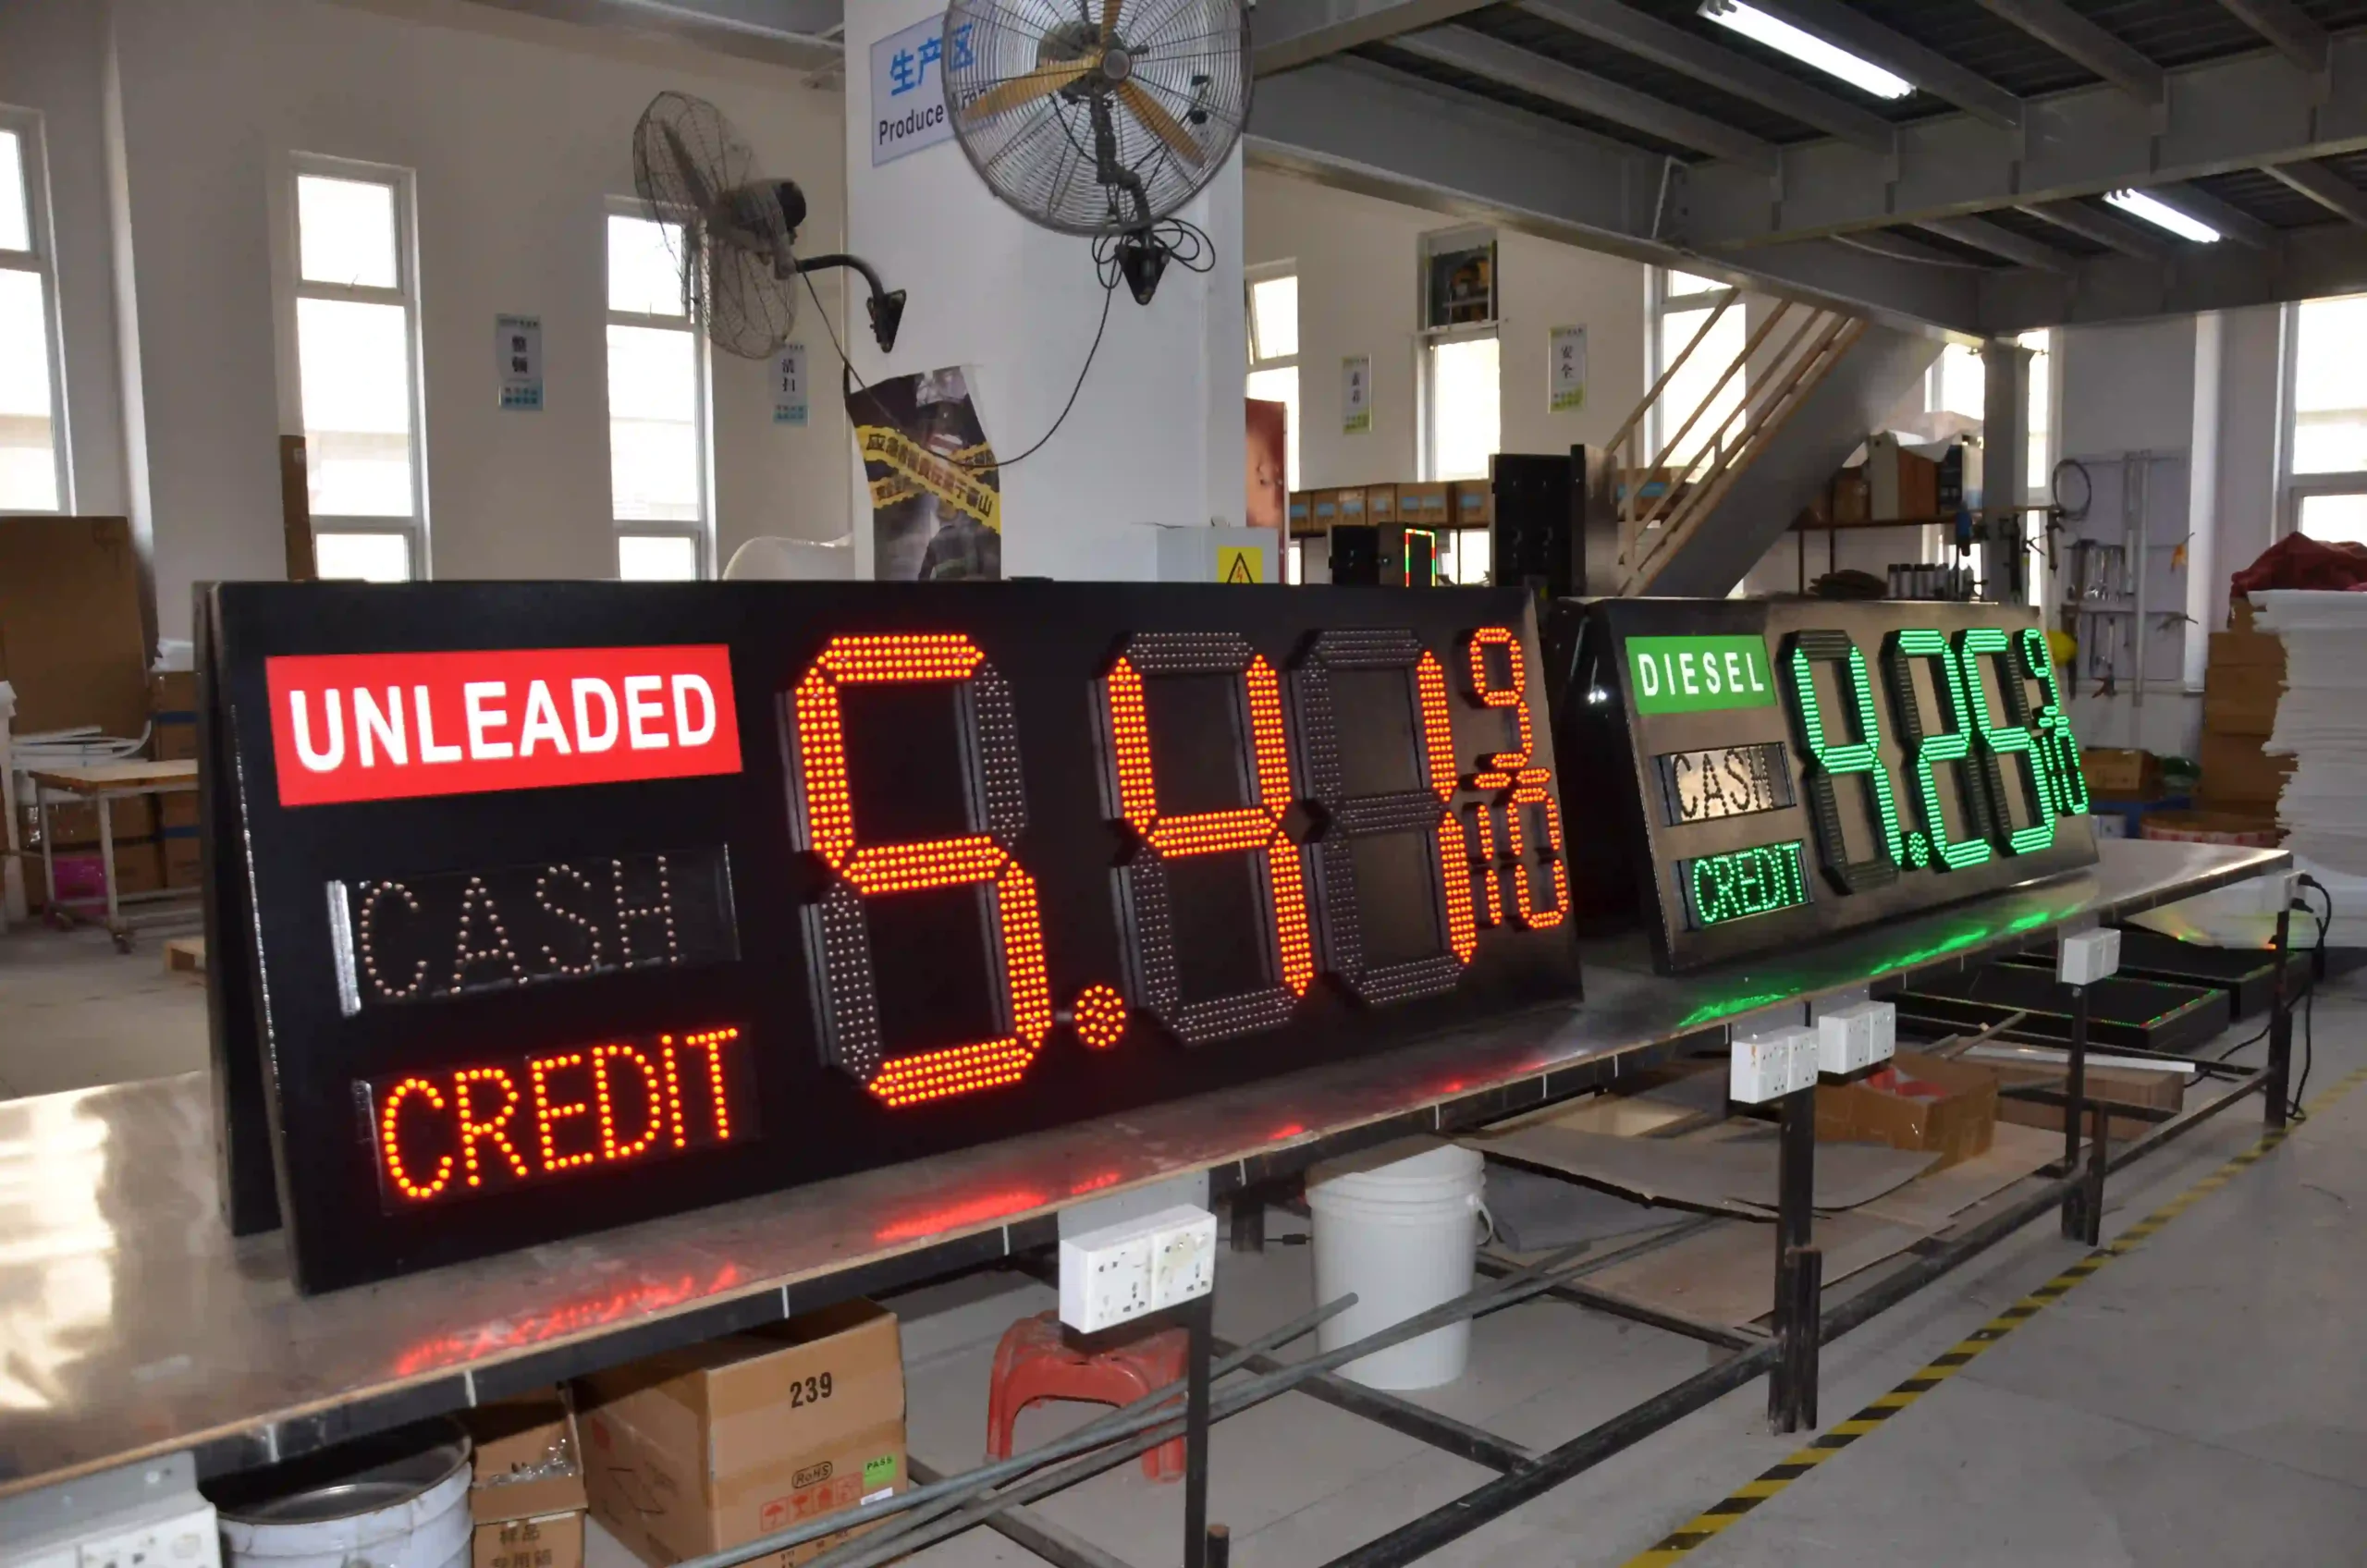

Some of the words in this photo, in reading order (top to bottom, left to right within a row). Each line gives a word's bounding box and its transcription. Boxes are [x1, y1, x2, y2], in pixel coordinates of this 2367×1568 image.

[889, 24, 975, 96] 生产区
[878, 104, 944, 144] Produce
[781, 358, 796, 392] 清扫
[1560, 345, 1575, 379] 安全
[1637, 652, 1764, 696] DIESEL
[288, 674, 717, 773] UNLEADED
[1673, 744, 1774, 818] CASH
[1694, 842, 1803, 923] CREDIT
[361, 855, 686, 998] CASH
[381, 1028, 738, 1199] CREDIT
[790, 1371, 832, 1408] 239
[795, 1464, 830, 1486] RoHS
[866, 1455, 893, 1471] PASS
[499, 1524, 540, 1545] 样品
